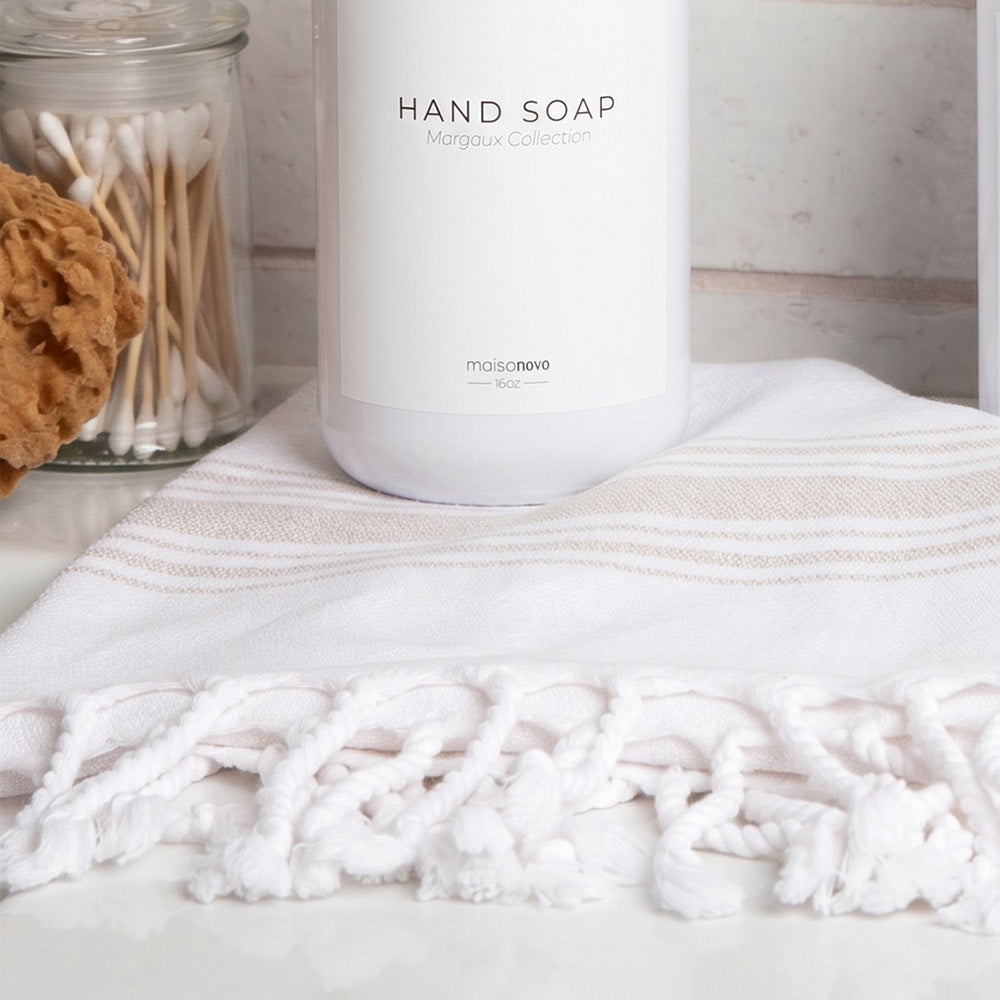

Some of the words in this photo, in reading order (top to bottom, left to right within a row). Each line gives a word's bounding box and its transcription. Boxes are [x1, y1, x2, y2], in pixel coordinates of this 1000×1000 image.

[398, 96, 502, 124] HAND
[519, 94, 616, 124] SOAP
[426, 129, 503, 151] Margaux
[507, 127, 592, 147] Collection
[466, 357, 551, 373] maisonovo
[494, 377, 522, 390] 16oz
